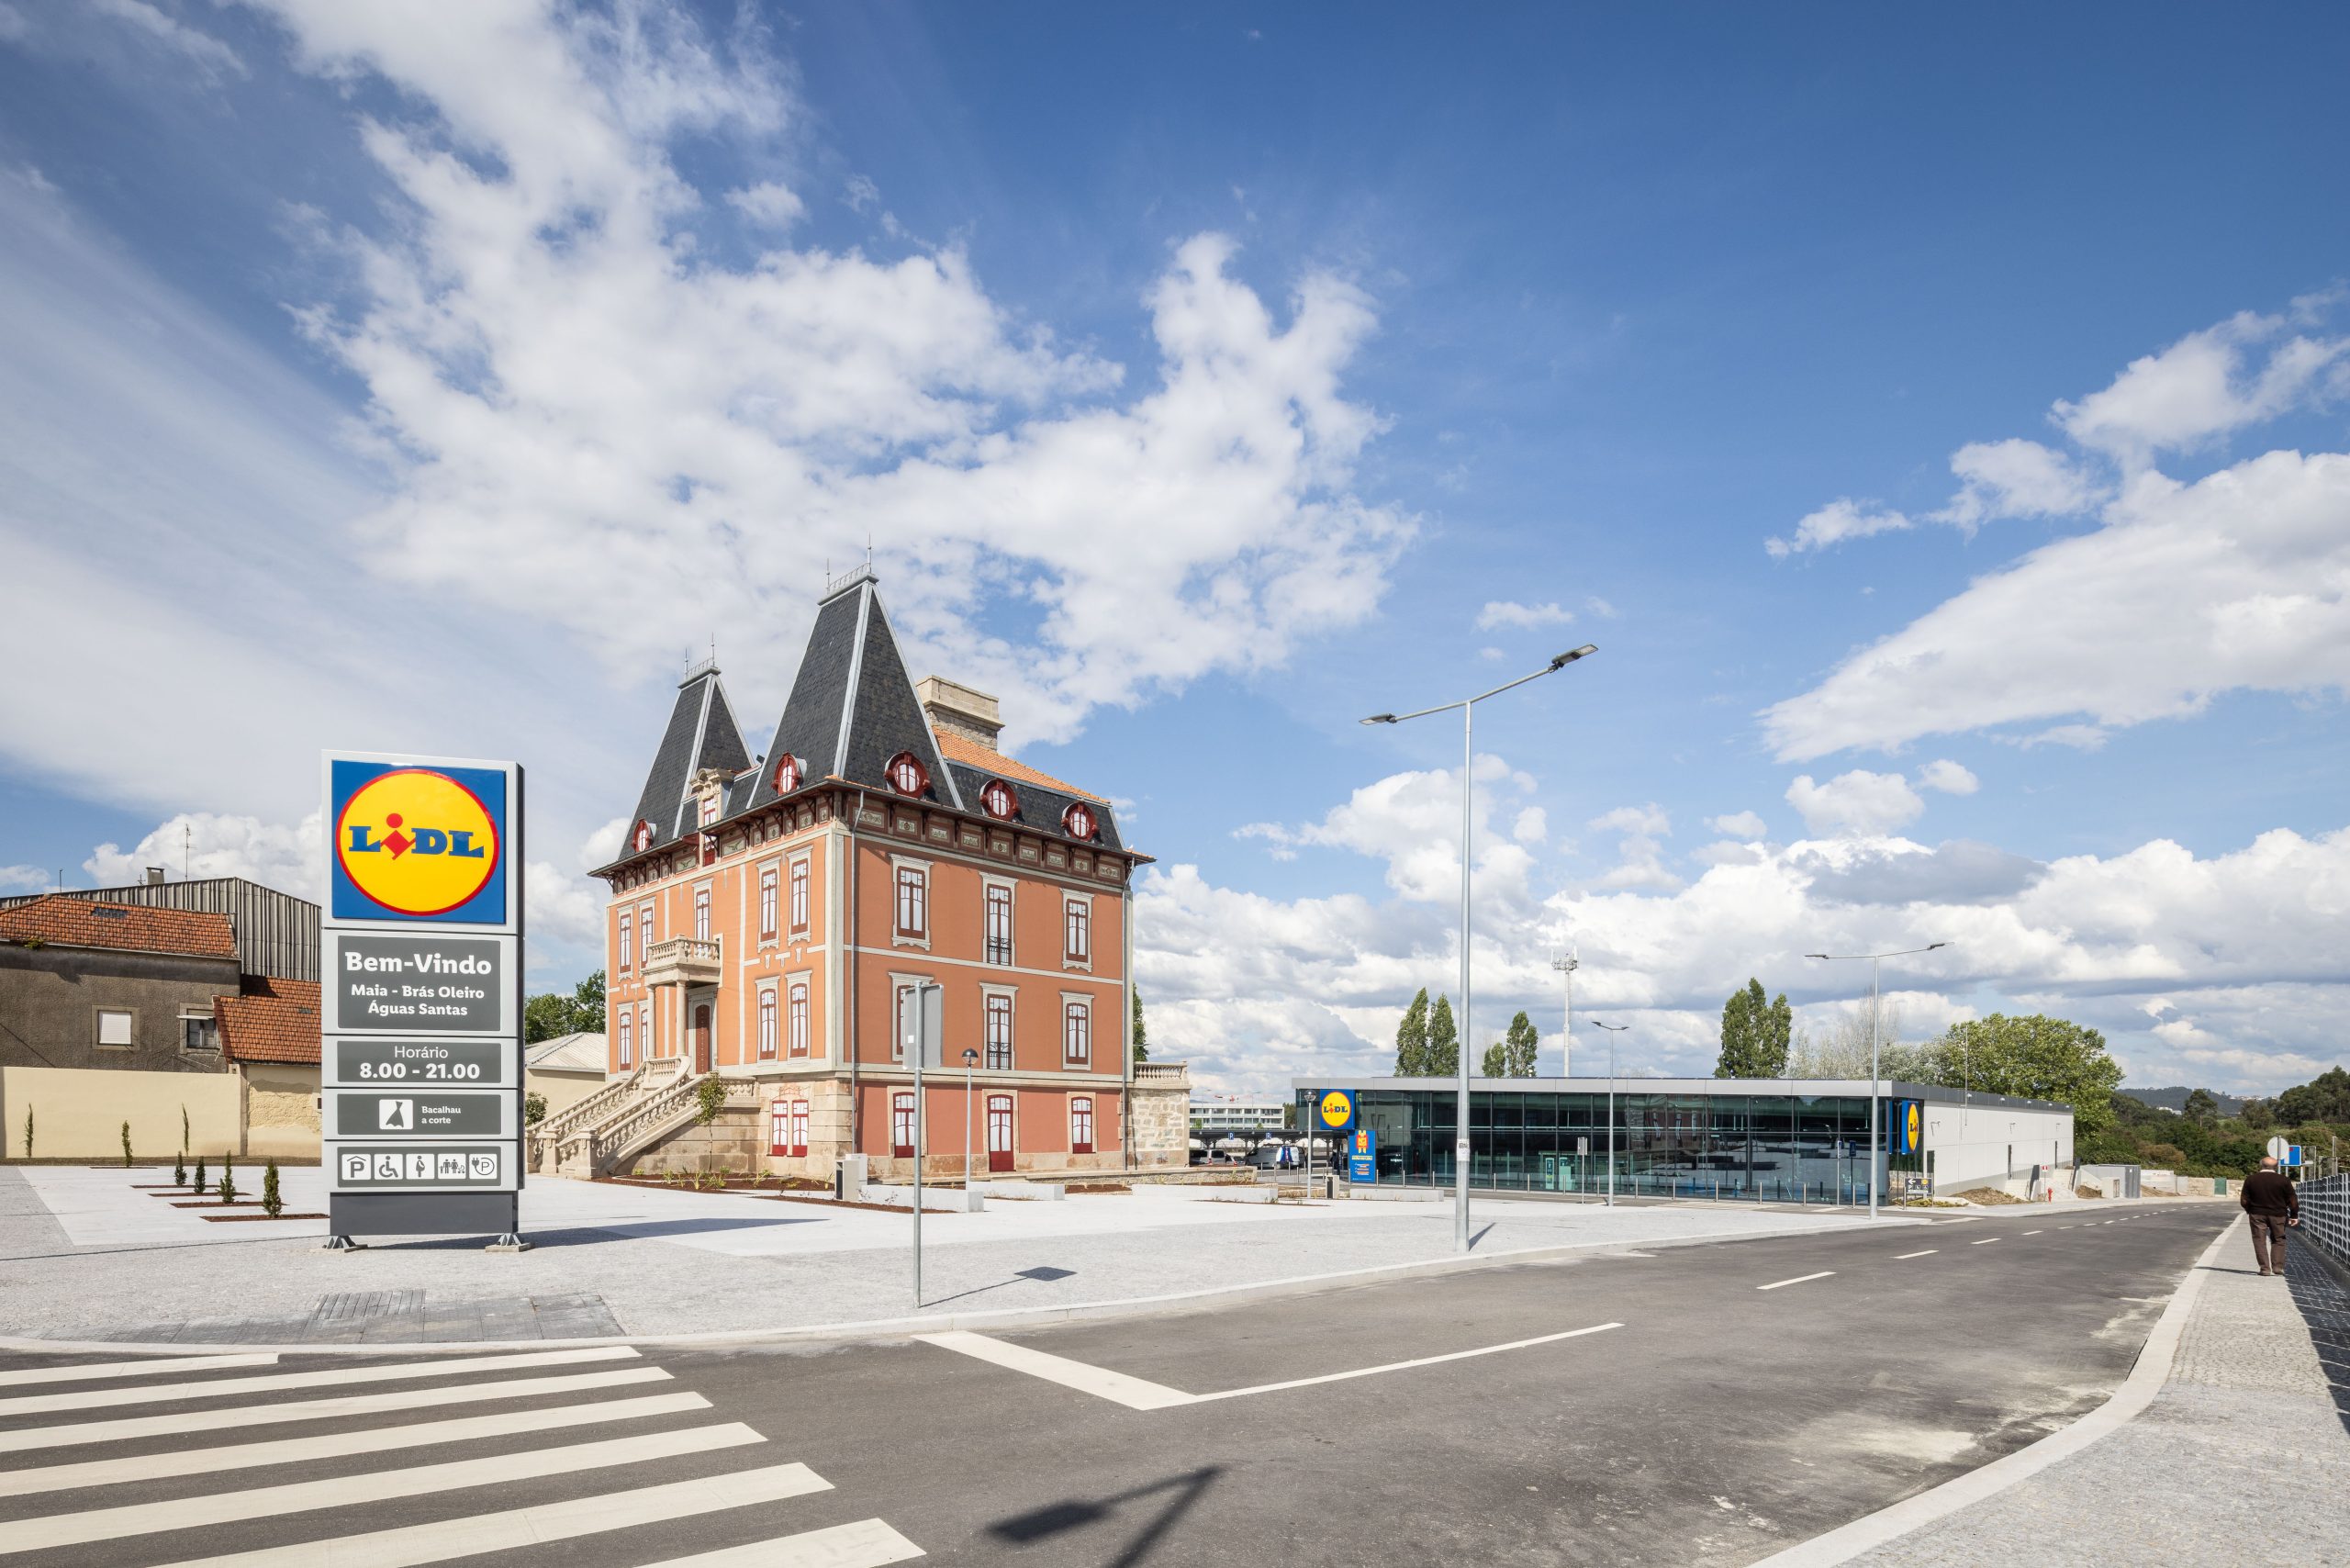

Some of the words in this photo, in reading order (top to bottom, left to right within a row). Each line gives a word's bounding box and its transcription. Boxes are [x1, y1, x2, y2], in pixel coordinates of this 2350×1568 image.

[345, 951, 492, 975] Bem-Vindo
[351, 983, 387, 997] Maia
[402, 984, 434, 998] Brás
[439, 986, 485, 1000] Oleiro
[368, 1000, 415, 1017] Águas
[419, 1002, 468, 1016] Santas
[394, 1045, 449, 1059] Horário
[359, 1062, 407, 1079] 8.00
[425, 1063, 481, 1080] 21.00
[421, 1105, 462, 1114] Bacalhau
[429, 1115, 452, 1125] corte
[350, 1160, 364, 1178] P
[481, 1161, 489, 1172] P
